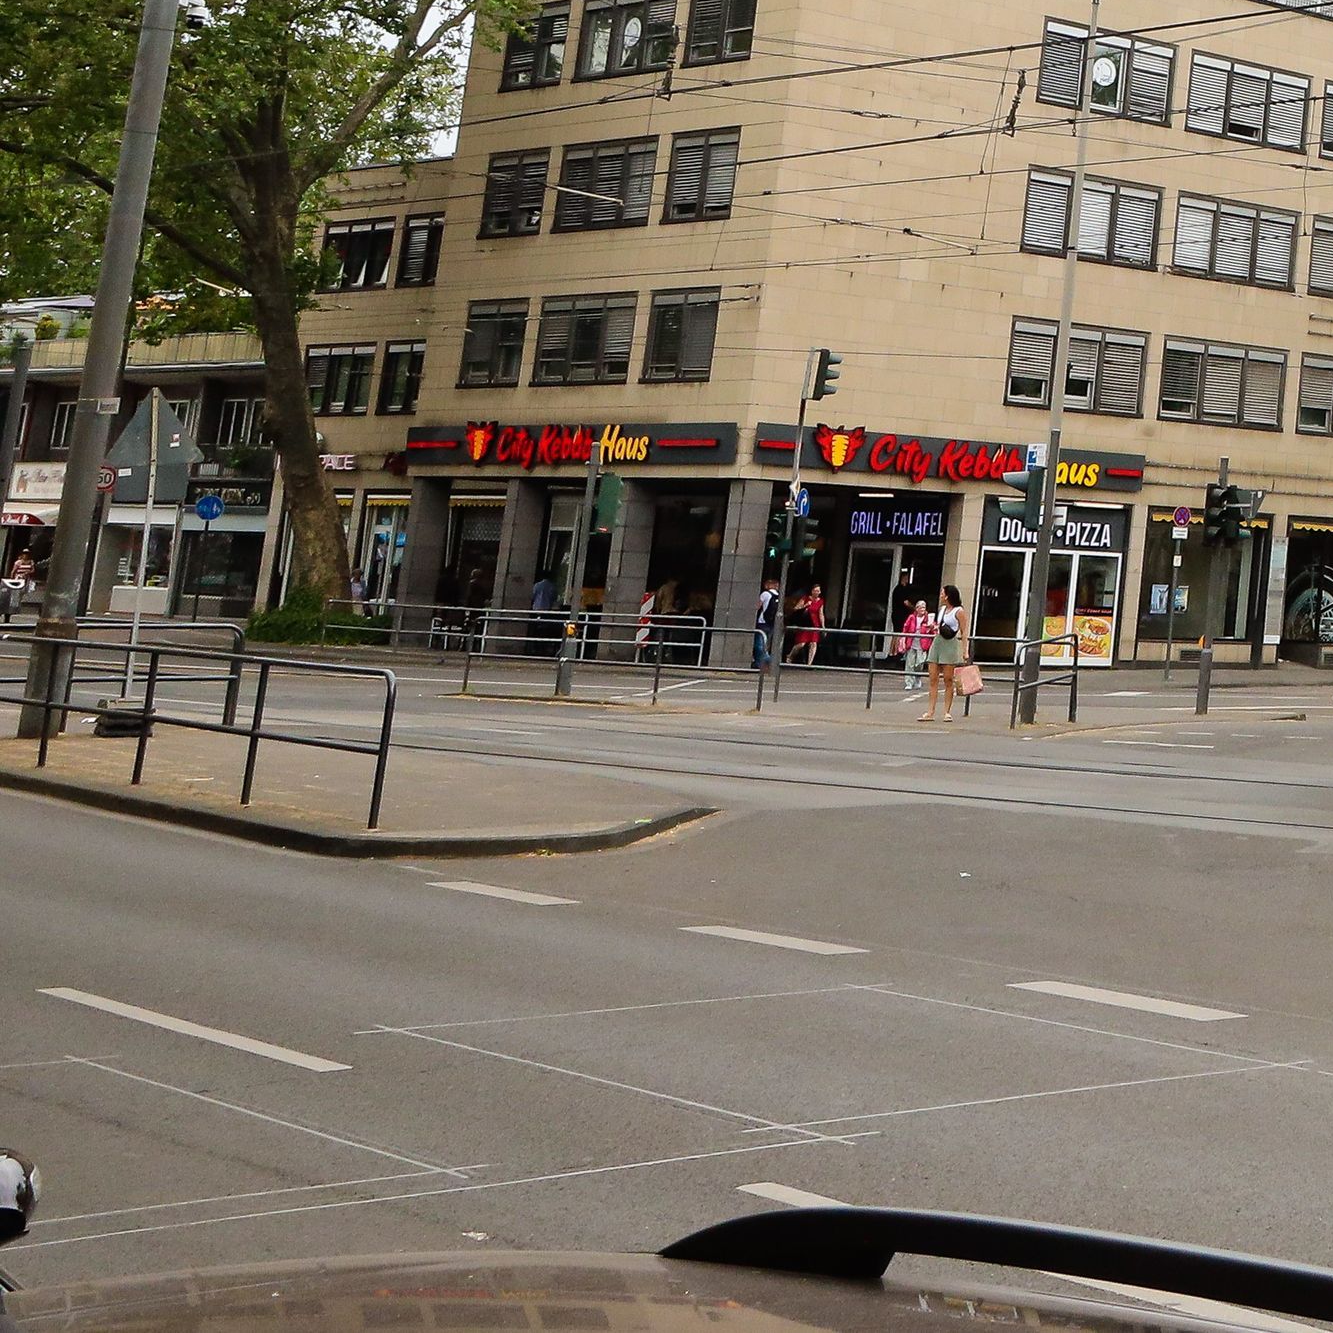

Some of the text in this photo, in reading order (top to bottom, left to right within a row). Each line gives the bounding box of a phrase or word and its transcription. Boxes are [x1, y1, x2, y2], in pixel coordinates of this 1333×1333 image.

[497, 426, 535, 470] City
[600, 424, 648, 463] Haus
[869, 433, 1099, 488] City Kebab aus
[851, 511, 944, 537] GRILL FALAFEL
[1065, 522, 1111, 548] PIZZA
